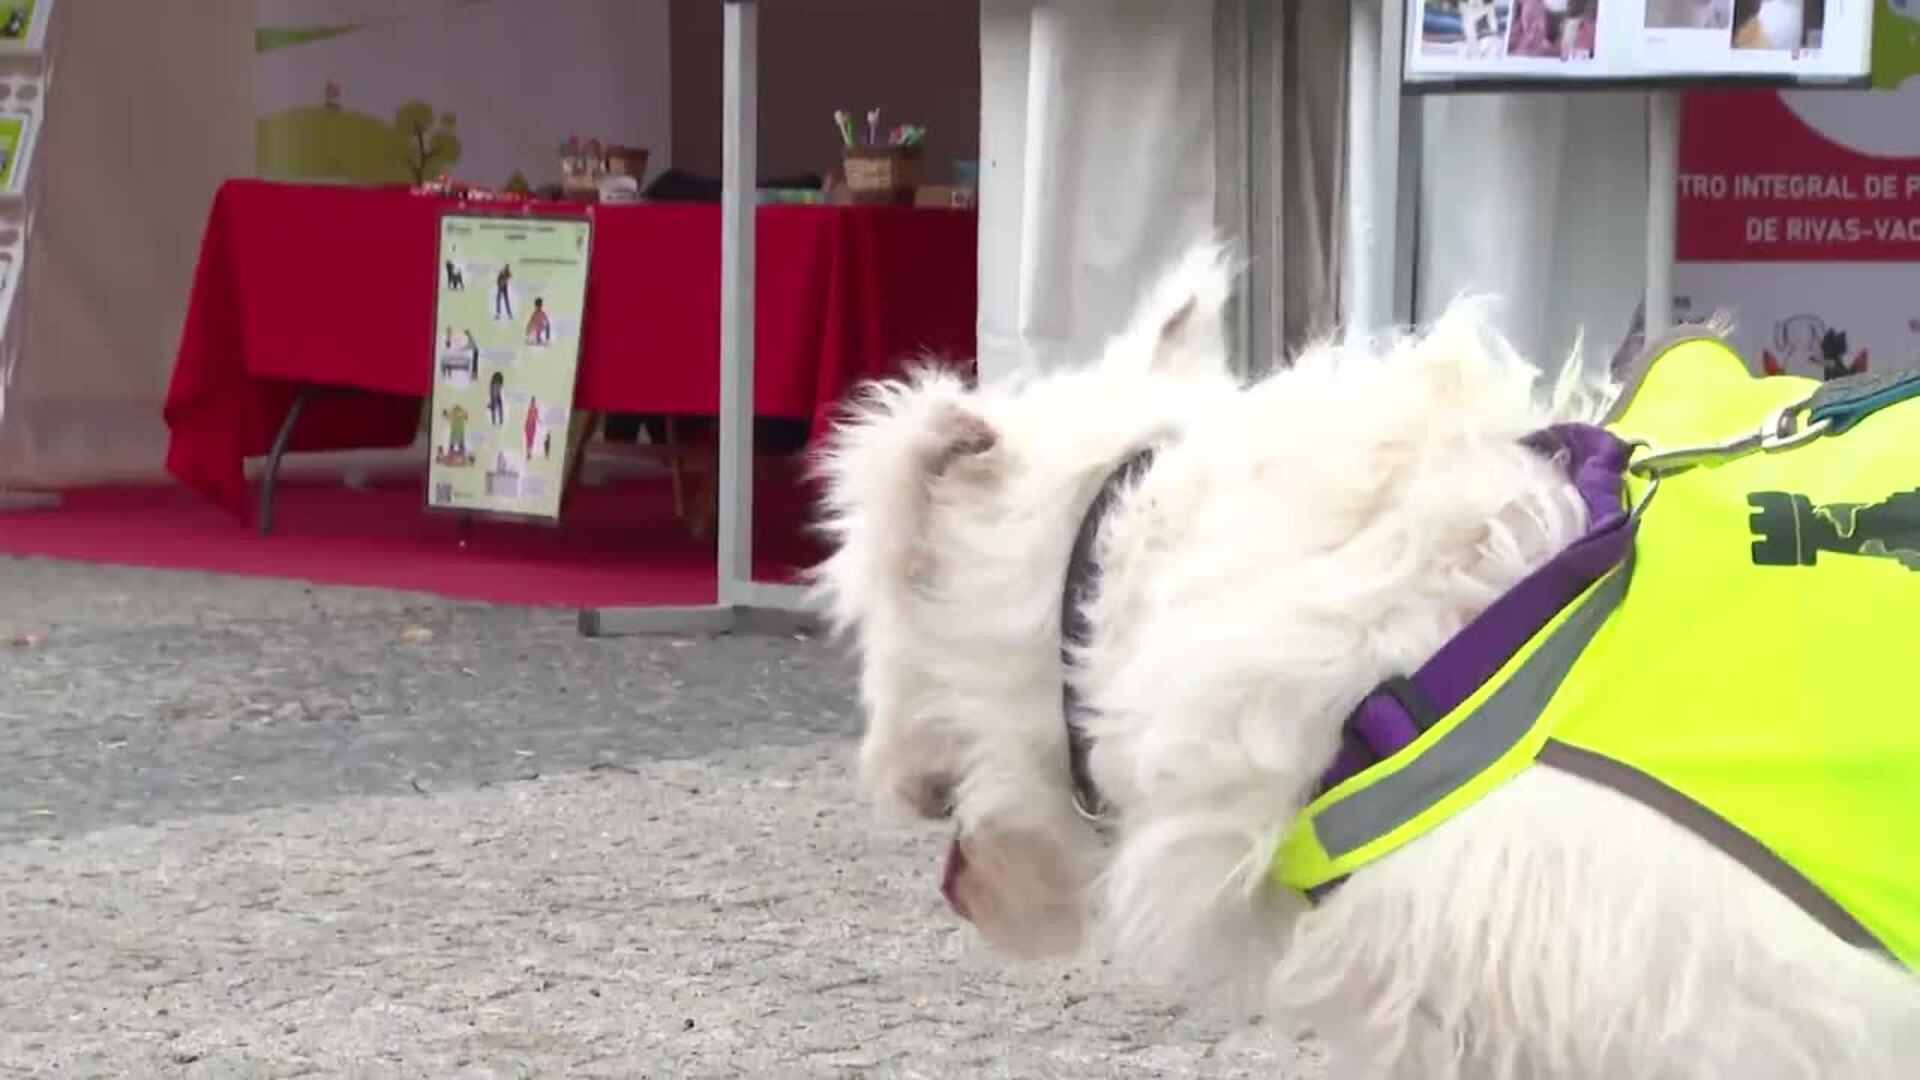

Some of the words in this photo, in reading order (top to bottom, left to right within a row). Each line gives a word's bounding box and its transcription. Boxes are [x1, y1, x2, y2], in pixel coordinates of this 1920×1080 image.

[1734, 174, 1857, 199] INTEGRAL
[1864, 174, 1897, 199] DE
[1746, 217, 1777, 242] DE
